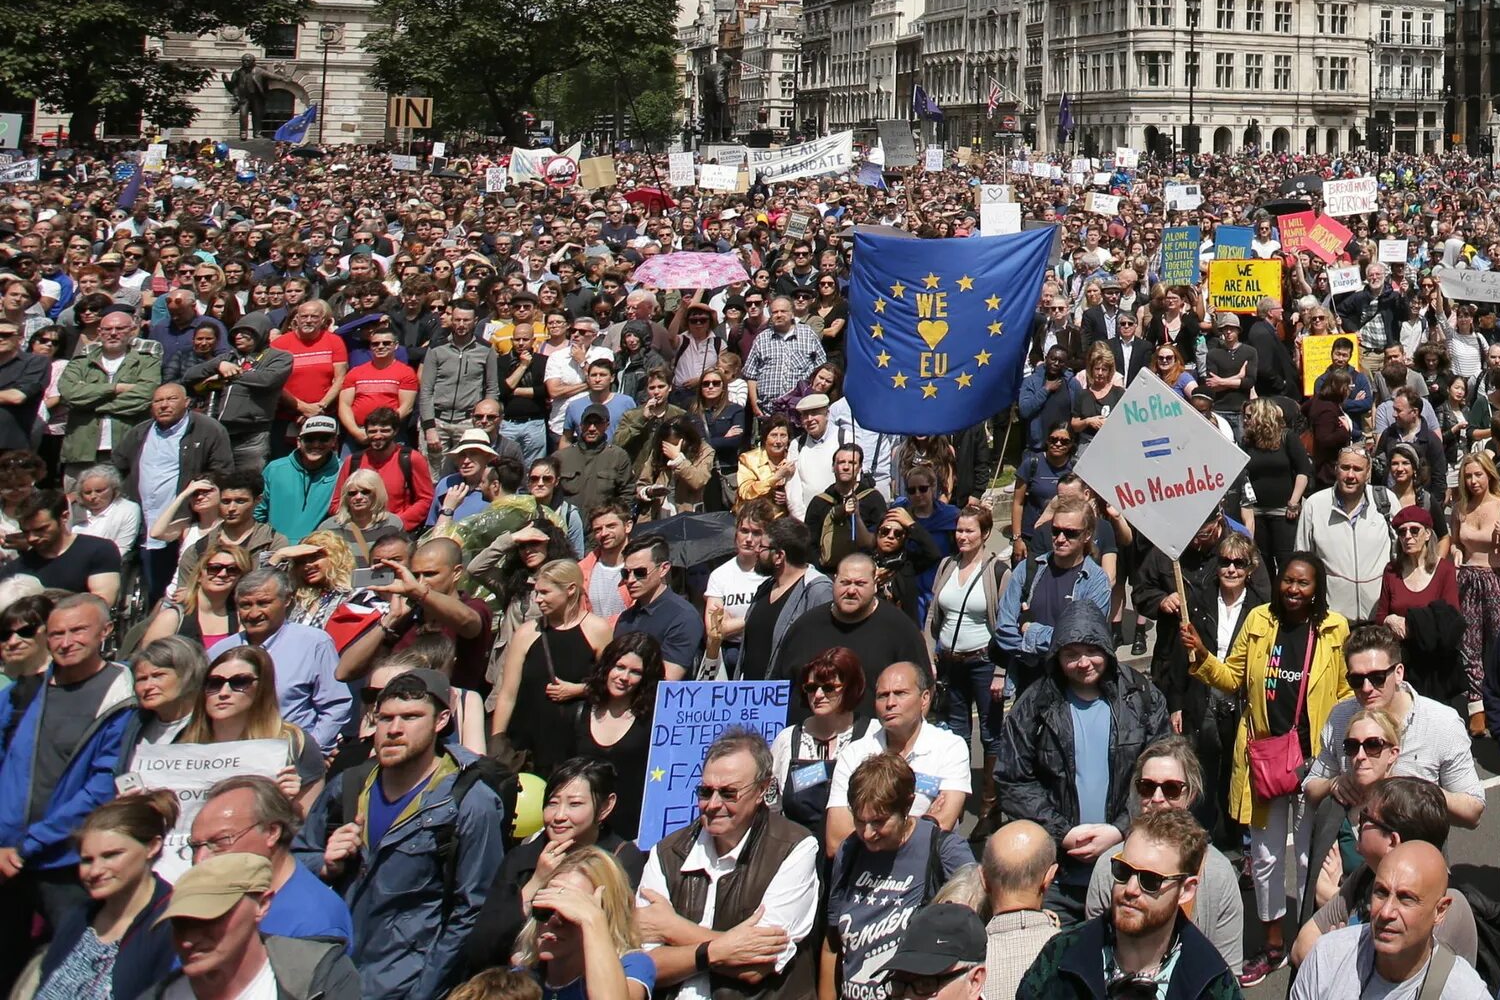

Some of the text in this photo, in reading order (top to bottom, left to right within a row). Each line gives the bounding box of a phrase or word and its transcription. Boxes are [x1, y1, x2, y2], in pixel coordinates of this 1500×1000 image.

[395, 98, 429, 127] IN
[753, 150, 772, 161] NO
[780, 143, 818, 159] PLAN
[755, 153, 845, 178] NO MANDATE
[1328, 180, 1377, 195] BREXIT HURTS
[1328, 195, 1375, 214] EVERYONE
[1288, 217, 1304, 228] WILL
[1165, 231, 1189, 242] ALONE
[1284, 227, 1307, 238] ALWAYS
[1164, 240, 1198, 251] WE CAN DO
[1165, 251, 1174, 262] SO
[1165, 259, 1194, 270] TOGETHER
[1237, 263, 1254, 276] WE
[1164, 269, 1193, 279] WE CAN DO
[1224, 279, 1261, 292] ARE ALL
[1333, 276, 1358, 288] Europe
[915, 291, 949, 318] WE
[919, 352, 948, 378] EU
[1123, 393, 1184, 425] No Plan
[305, 422, 335, 430] RAIDERS
[1114, 464, 1225, 511] No Mandate
[664, 684, 790, 709] MY FUTURE
[676, 708, 760, 725] SHOULD BE
[138, 757, 241, 771] I LOVE EUROPE
[855, 871, 914, 893] Original
[839, 903, 921, 953] Fender
